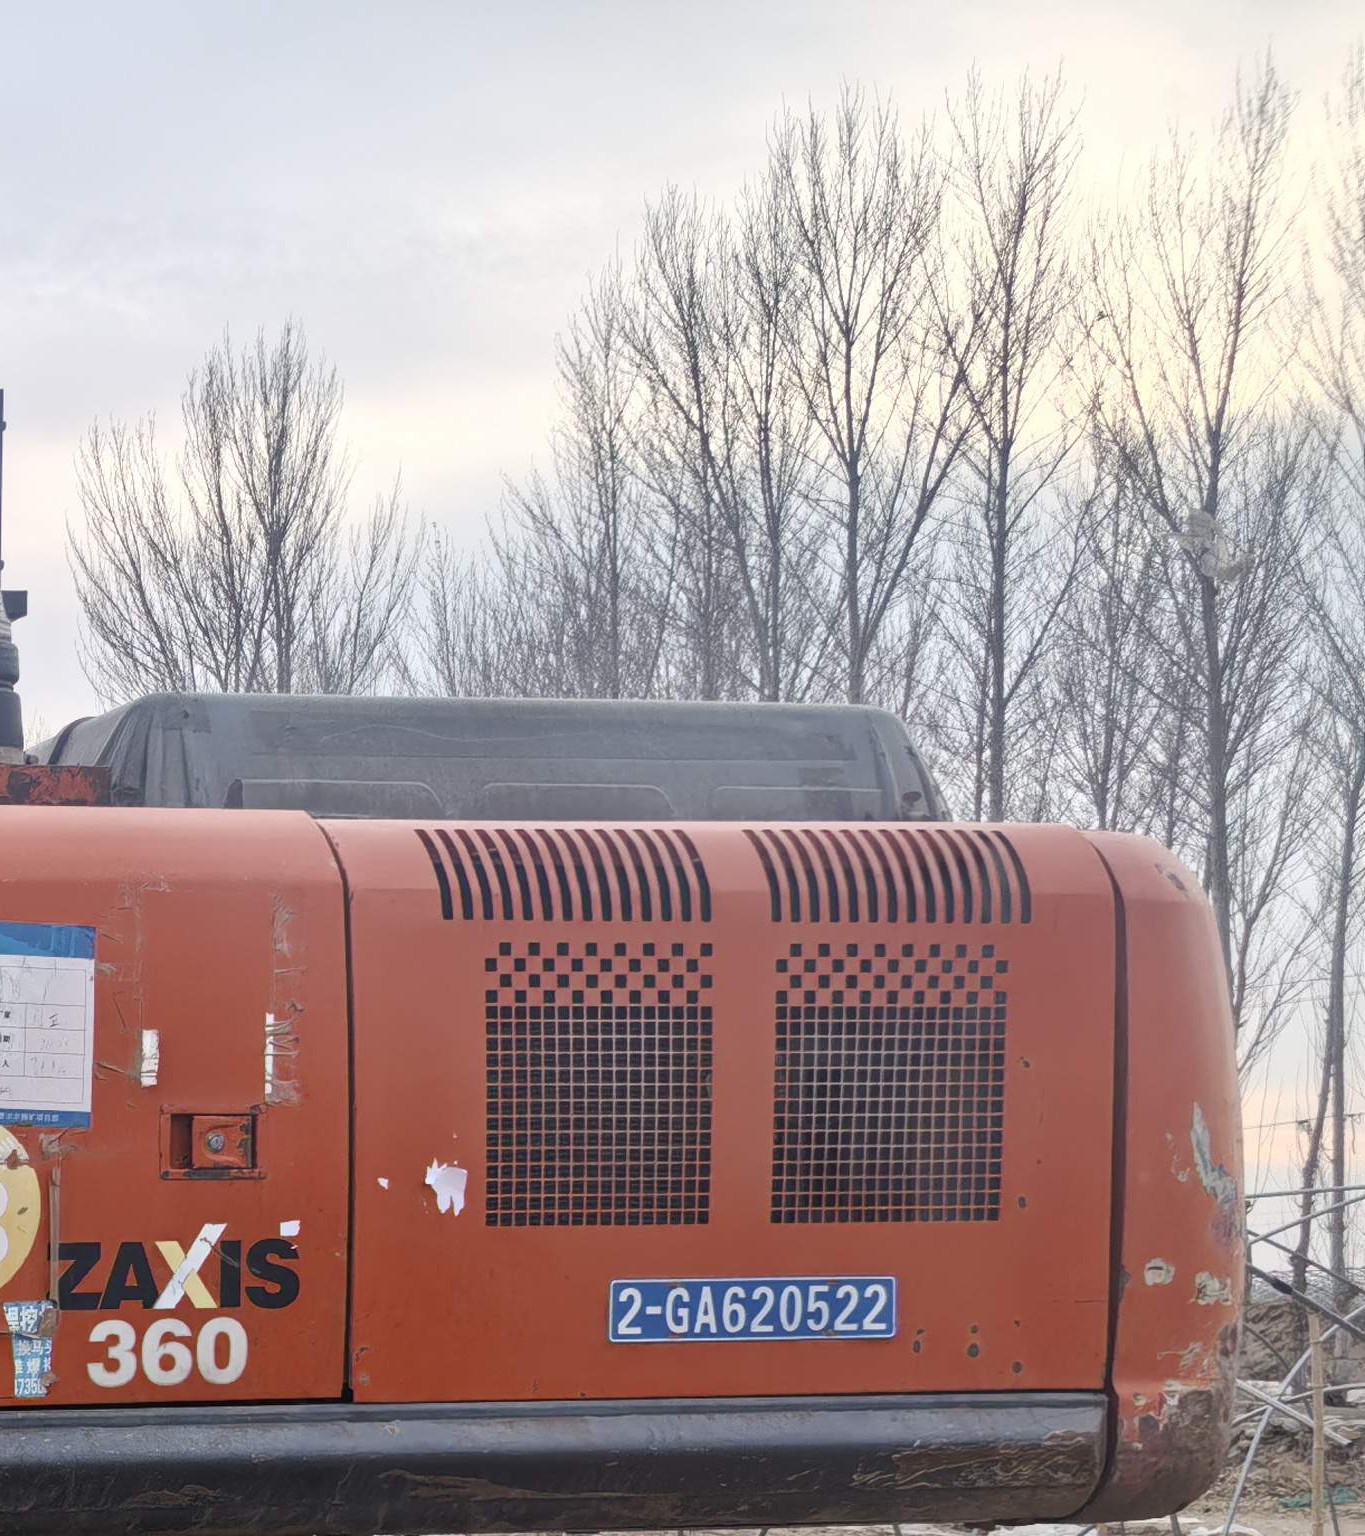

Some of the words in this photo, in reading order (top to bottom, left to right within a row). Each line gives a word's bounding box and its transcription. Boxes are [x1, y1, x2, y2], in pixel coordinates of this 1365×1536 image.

[48, 1223, 301, 1310] ZAXIS
[617, 1283, 888, 1335] 2-GA620522
[86, 1316, 249, 1388] 360
